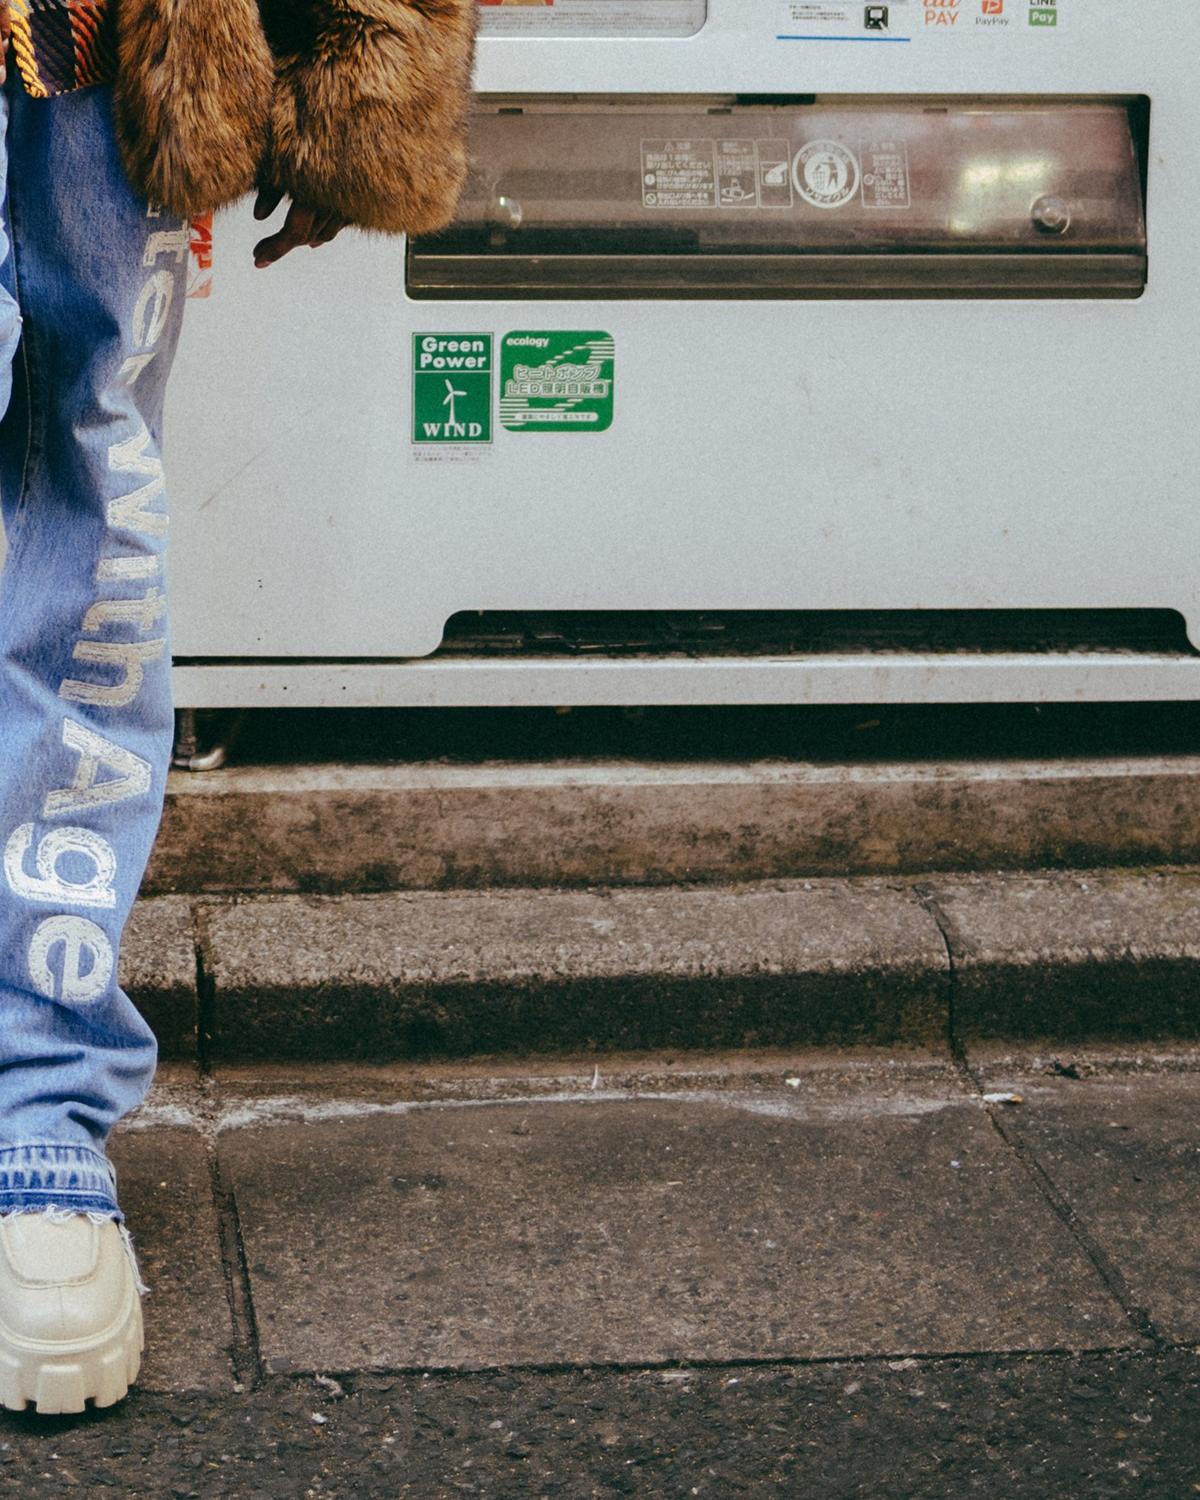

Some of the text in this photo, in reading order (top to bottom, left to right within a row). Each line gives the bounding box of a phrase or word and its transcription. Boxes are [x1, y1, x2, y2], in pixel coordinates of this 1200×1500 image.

[924, 10, 959, 26] PAY
[975, 17, 1009, 27] PayPay
[1032, 11, 1054, 23] Pay
[421, 337, 485, 352] Green
[506, 336, 550, 347] ecology
[420, 353, 486, 369] Power
[514, 364, 601, 381] ヒートポンプ
[505, 381, 608, 396] LED照明自販機
[423, 423, 483, 437] WIND
[57, 418, 170, 708] With
[2, 716, 154, 1004] Age
